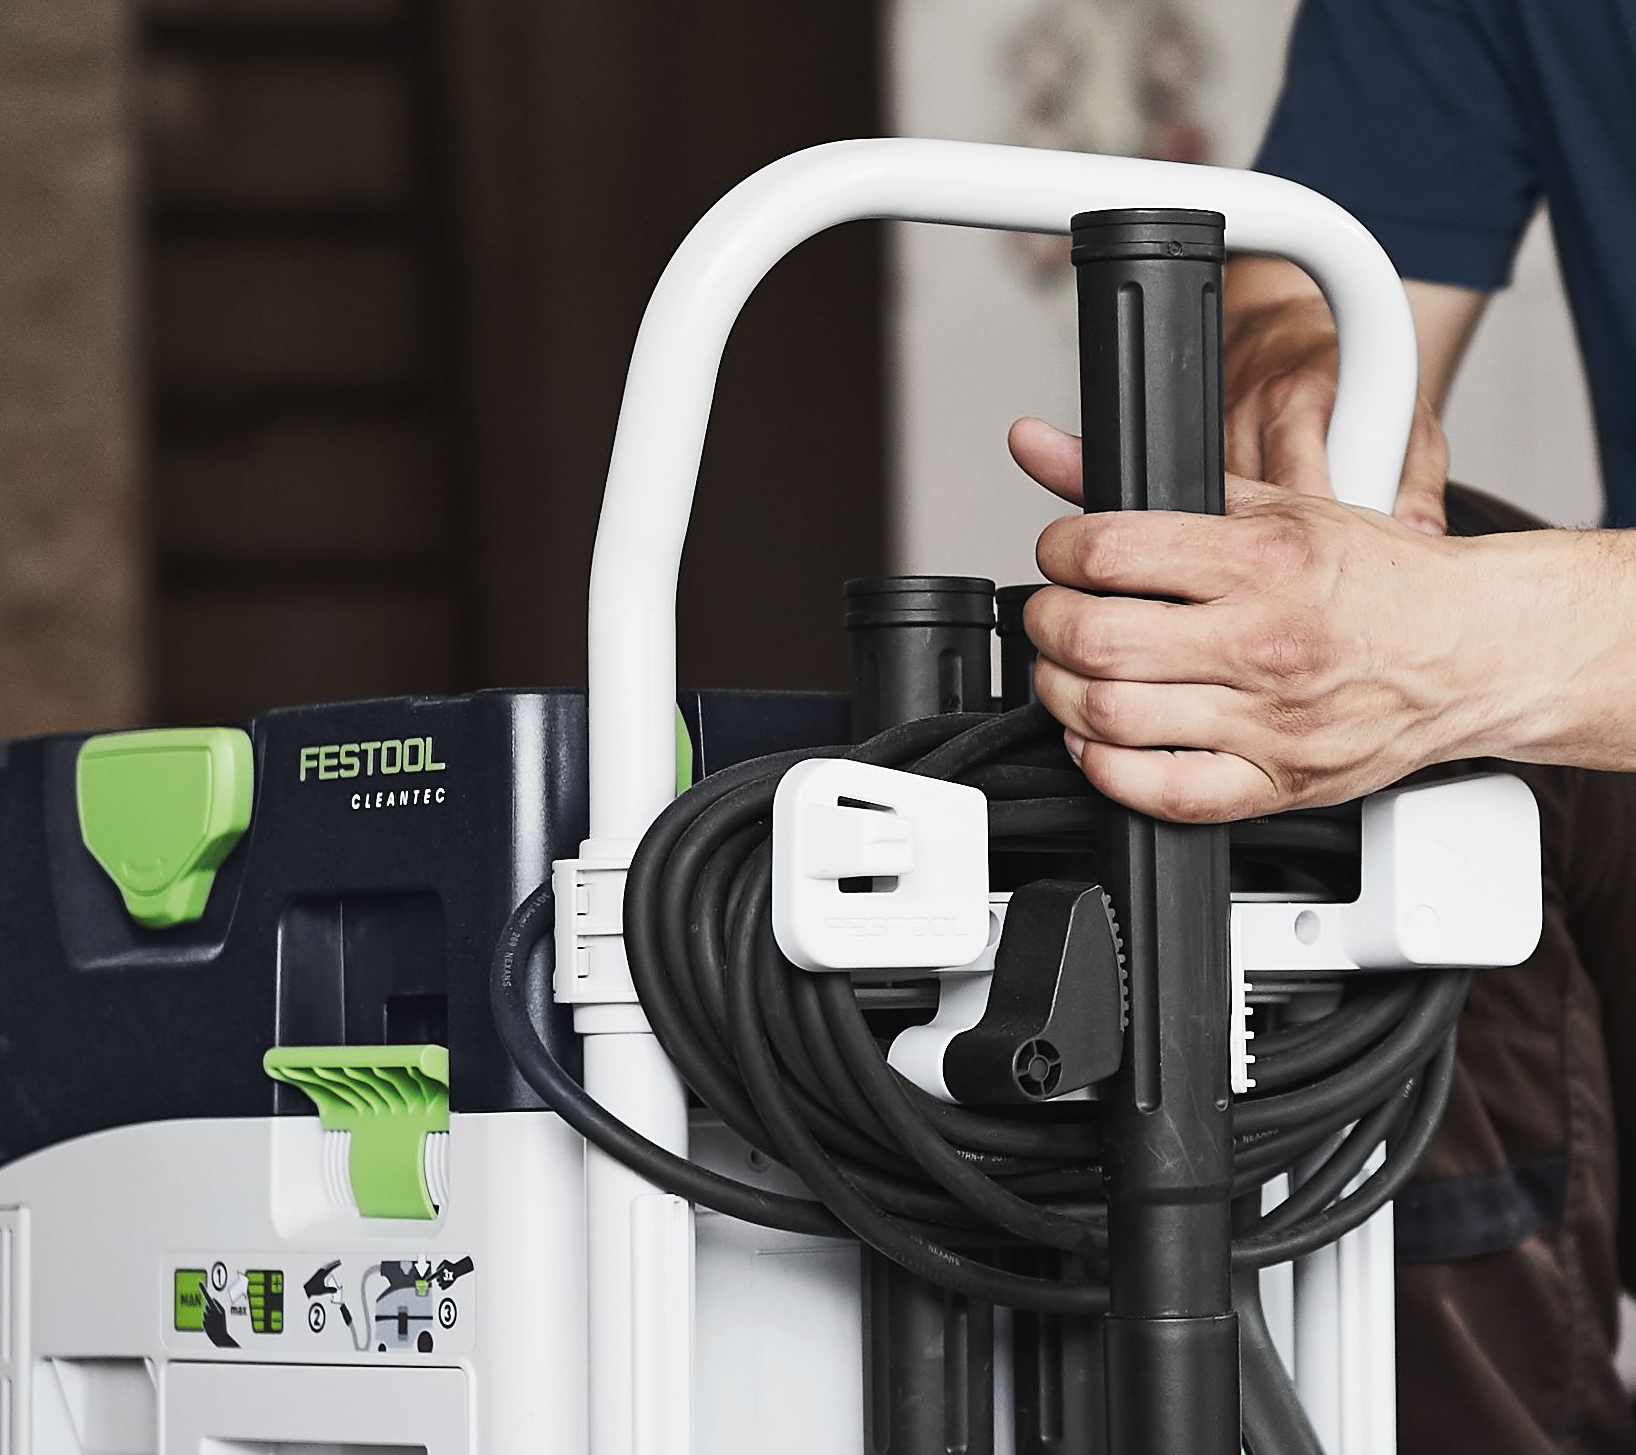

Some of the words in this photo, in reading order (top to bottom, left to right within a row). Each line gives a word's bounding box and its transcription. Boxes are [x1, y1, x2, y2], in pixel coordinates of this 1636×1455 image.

[299, 736, 446, 782] FESTOOL
[351, 787, 446, 810] CLEANTEC
[824, 916, 970, 937] FESTOOL
[502, 951, 515, 987] NEXANS
[442, 1269, 454, 1282] 3x
[180, 1292, 203, 1307] MAN
[230, 1306, 248, 1316] max
